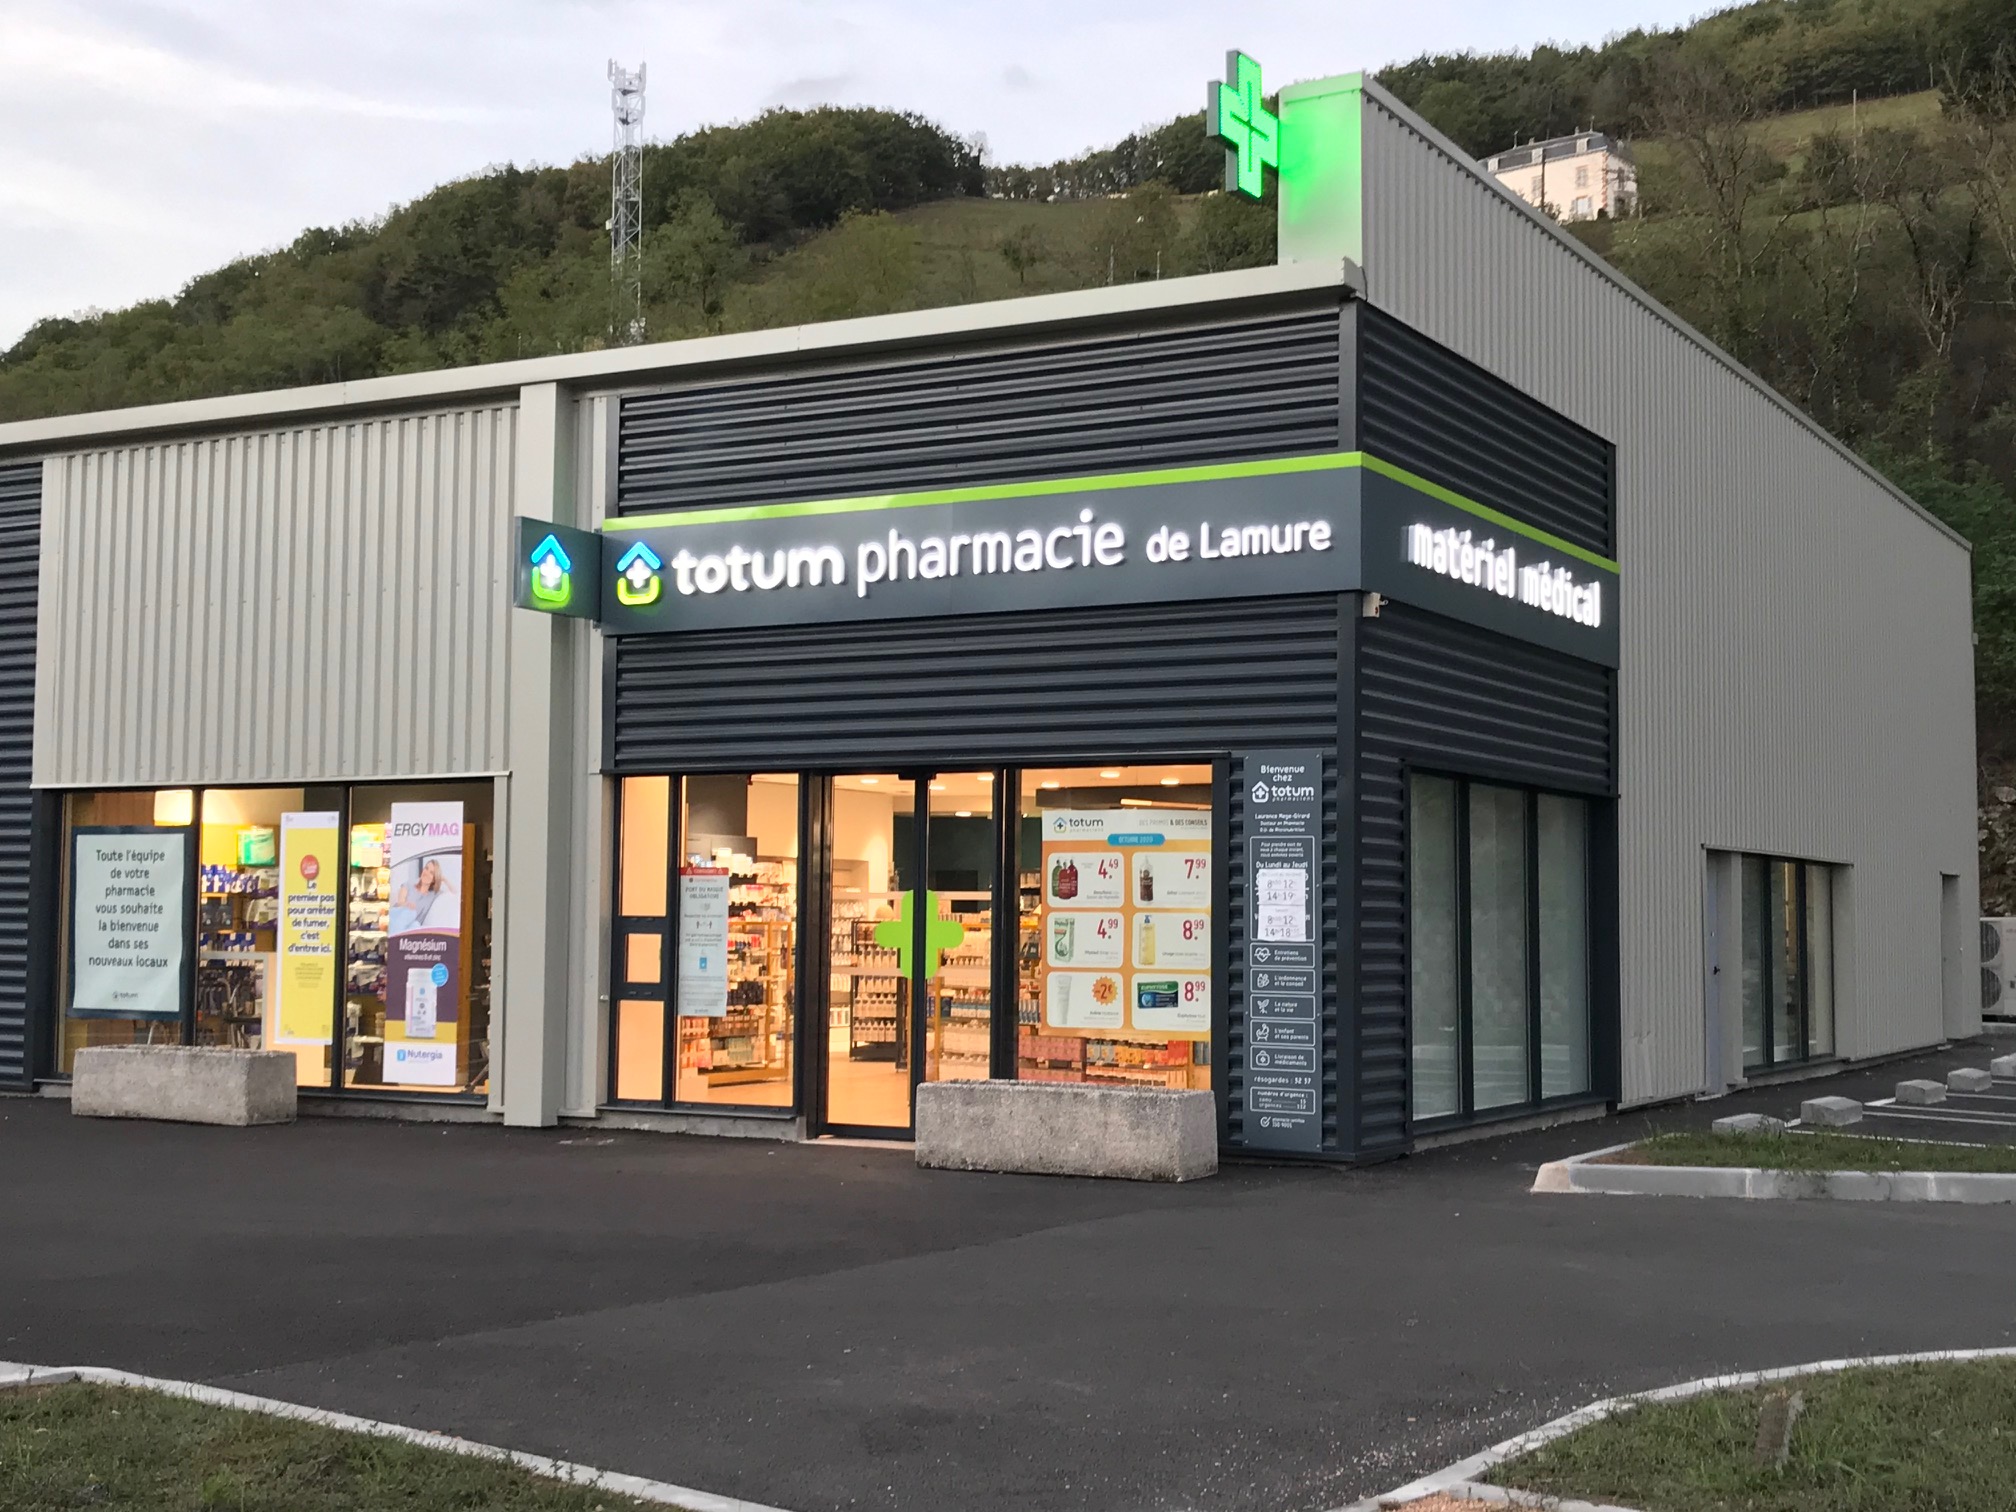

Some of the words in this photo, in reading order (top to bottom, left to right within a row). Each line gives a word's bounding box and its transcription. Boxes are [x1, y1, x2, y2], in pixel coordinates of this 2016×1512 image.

[672, 545, 845, 595] totum
[858, 509, 1125, 598] pharmacie
[1146, 525, 1190, 562] de
[1200, 520, 1332, 559] Lamure
[1408, 523, 1516, 598] matériel
[1518, 561, 1601, 628] médical
[1260, 765, 1305, 774] Bienvenue
[1271, 785, 1314, 796] totum
[1069, 818, 1104, 827] totum
[394, 823, 459, 836] ERGYMAG
[96, 849, 123, 862] Toute
[126, 849, 165, 863] l'équipe
[110, 868, 122, 879] de
[125, 869, 150, 879] votre
[307, 880, 316, 889] Le
[105, 885, 155, 899] pharmacie
[288, 892, 318, 904] premier
[320, 895, 334, 903] pas
[96, 904, 117, 914] vous
[120, 903, 164, 914] souhaite
[288, 908, 306, 916] pour
[307, 905, 335, 915] arrêter
[98, 920, 107, 932] la
[110, 920, 159, 932] bienvenue
[292, 918, 302, 927] de
[303, 918, 329, 928] fumer,
[301, 932, 320, 940] c'est
[108, 937, 130, 949] dans
[134, 940, 149, 950] ses
[288, 944, 319, 953] d'entrer
[399, 938, 447, 953] Magnésium
[89, 956, 133, 967] nouveaux
[136, 956, 168, 968] locaux
[407, 1049, 443, 1060] Nutergia
